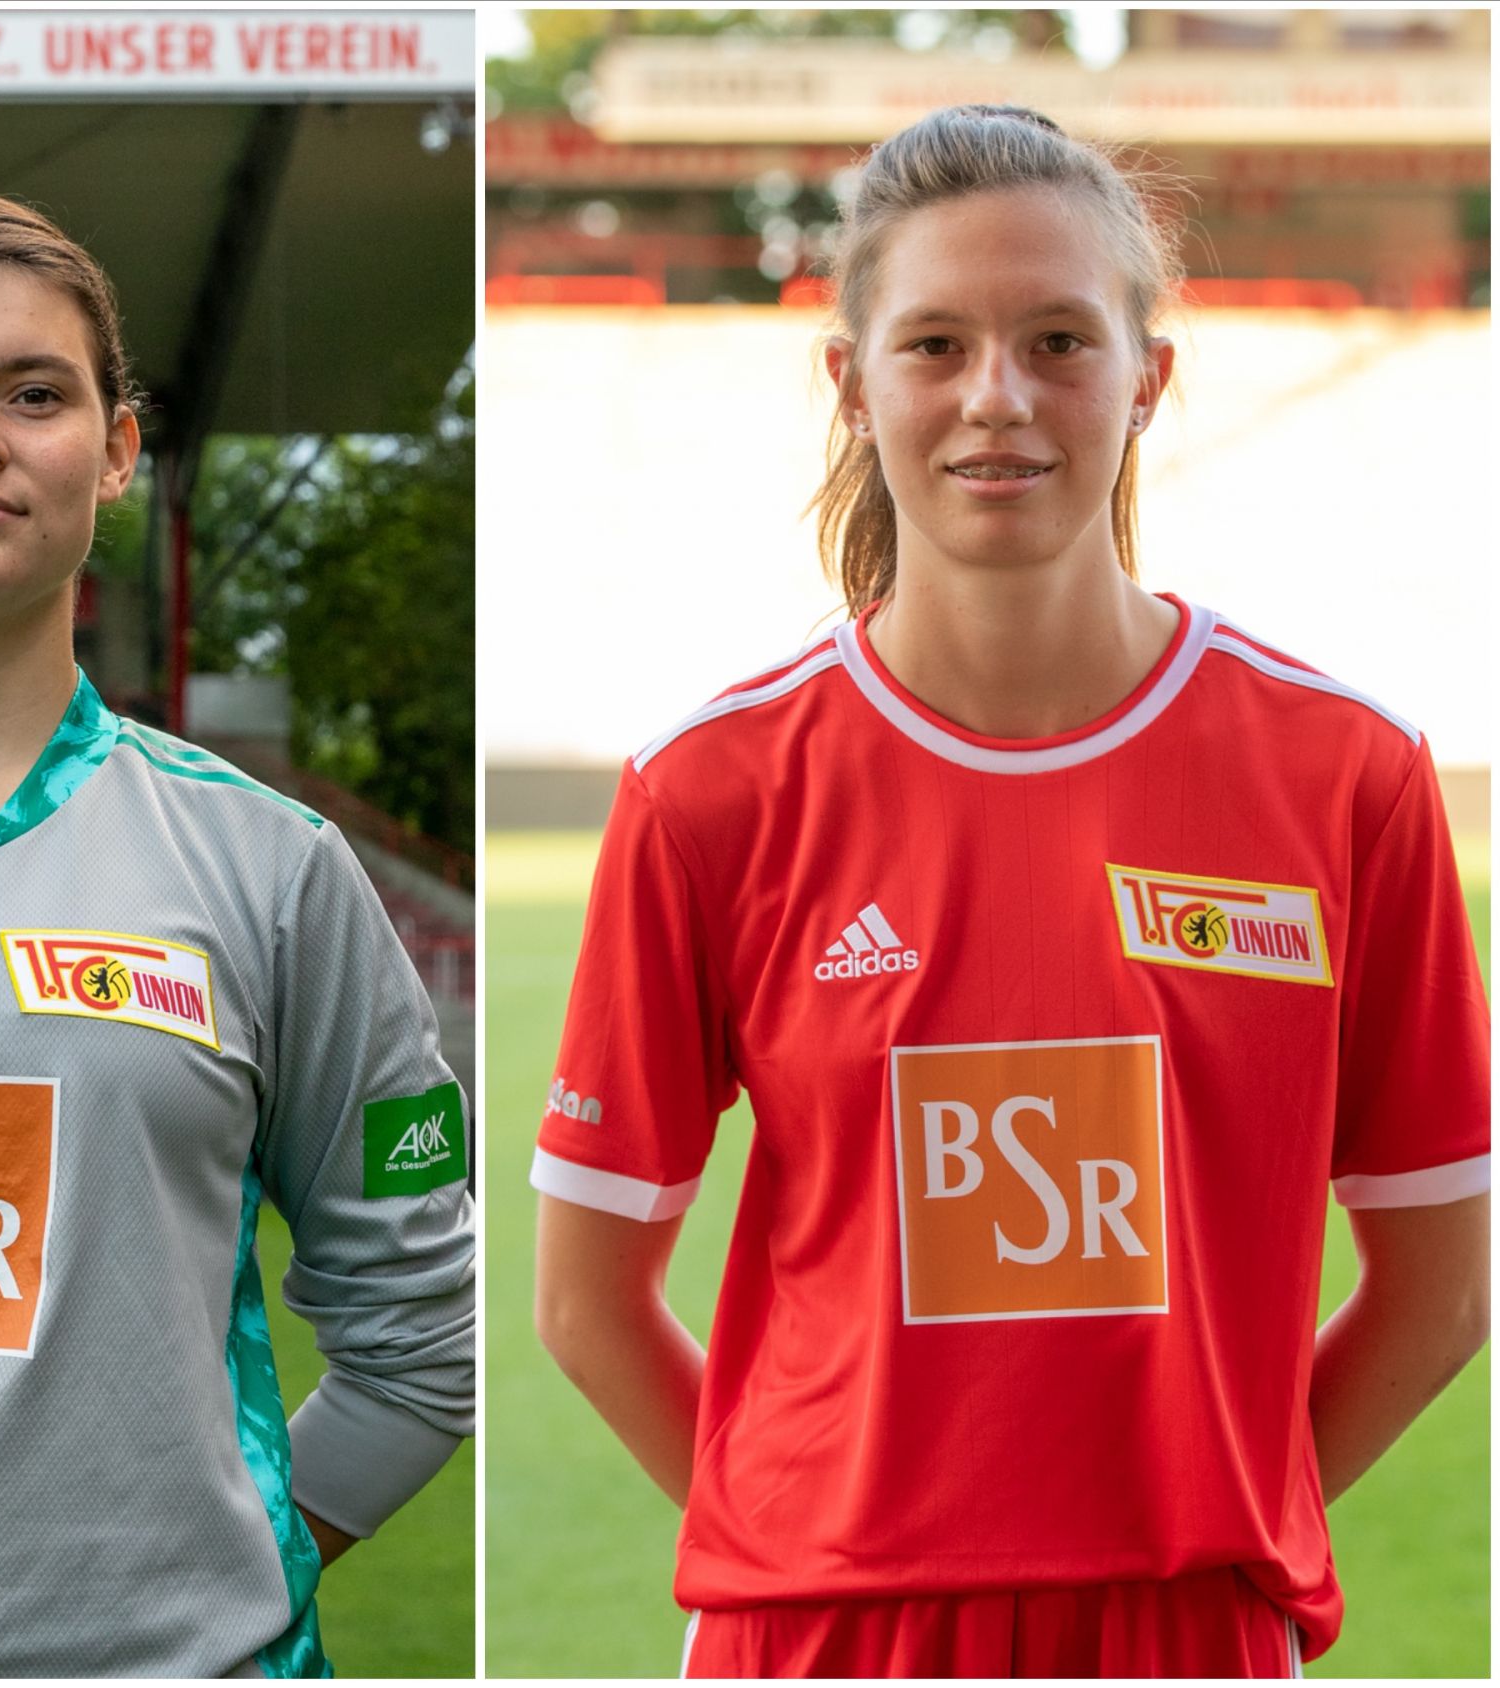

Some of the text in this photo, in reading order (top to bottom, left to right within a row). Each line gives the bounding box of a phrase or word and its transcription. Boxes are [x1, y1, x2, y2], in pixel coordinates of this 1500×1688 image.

[44, 23, 215, 76] UNSER
[237, 23, 438, 76] VEREIN.
[814, 948, 920, 981] adidas
[1231, 917, 1310, 962] UNION
[132, 971, 206, 1026] UNION
[387, 1111, 450, 1161] AOK
[384, 1162, 400, 1172] Die
[919, 1094, 1150, 1266] BSR
